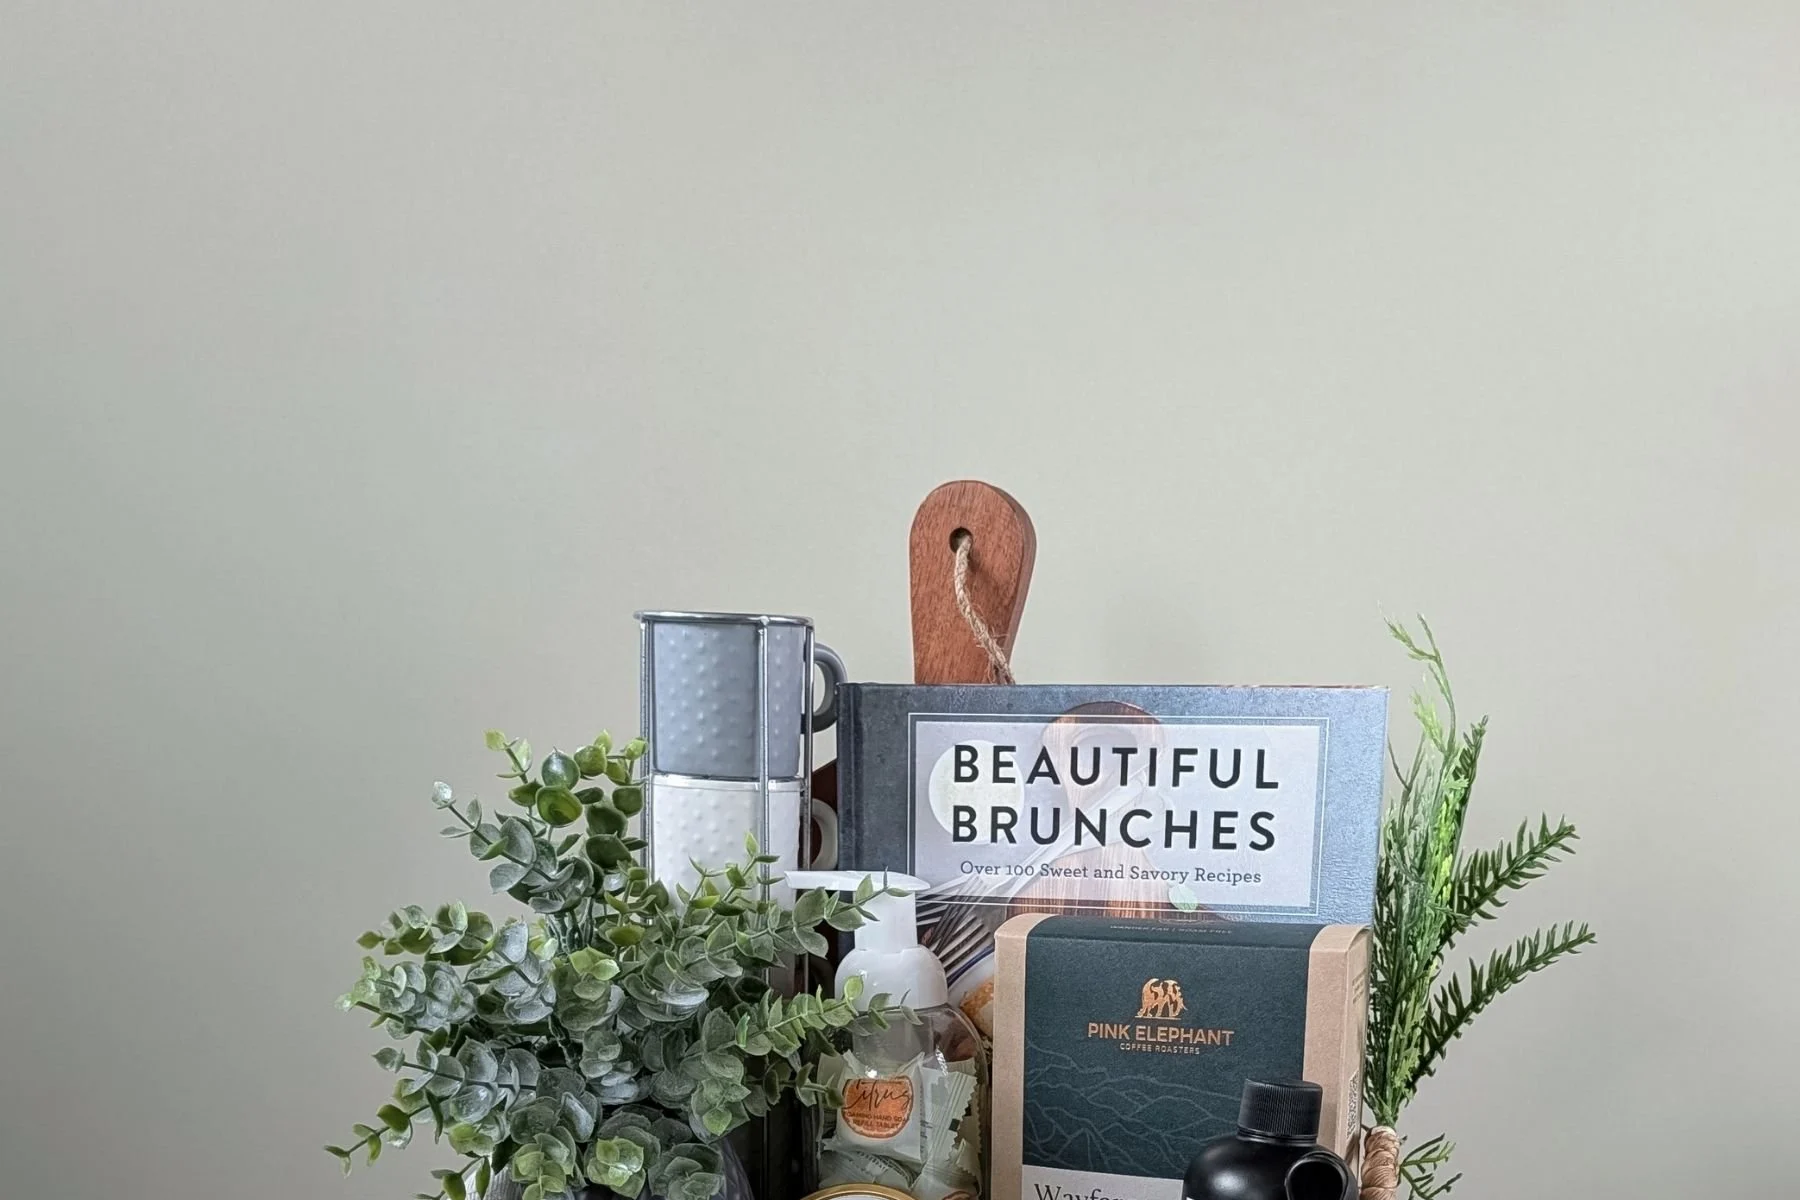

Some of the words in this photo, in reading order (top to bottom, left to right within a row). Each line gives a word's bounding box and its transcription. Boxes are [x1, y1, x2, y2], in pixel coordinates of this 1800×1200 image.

[954, 744, 1279, 790] BEAUTIFUL
[952, 805, 1276, 851] BRUNCHES
[960, 860, 1001, 876] Over
[1006, 863, 1035, 877] 100
[1040, 863, 1088, 879] Sweet
[1093, 864, 1125, 880] and
[1130, 866, 1189, 884] Savory
[1194, 868, 1262, 886] Recipes
[1087, 1022, 1130, 1041] PINK
[1135, 1026, 1235, 1046] ELEPHANT
[1119, 1042, 1152, 1052] COFFEE
[1155, 1045, 1200, 1055] ROASTERS
